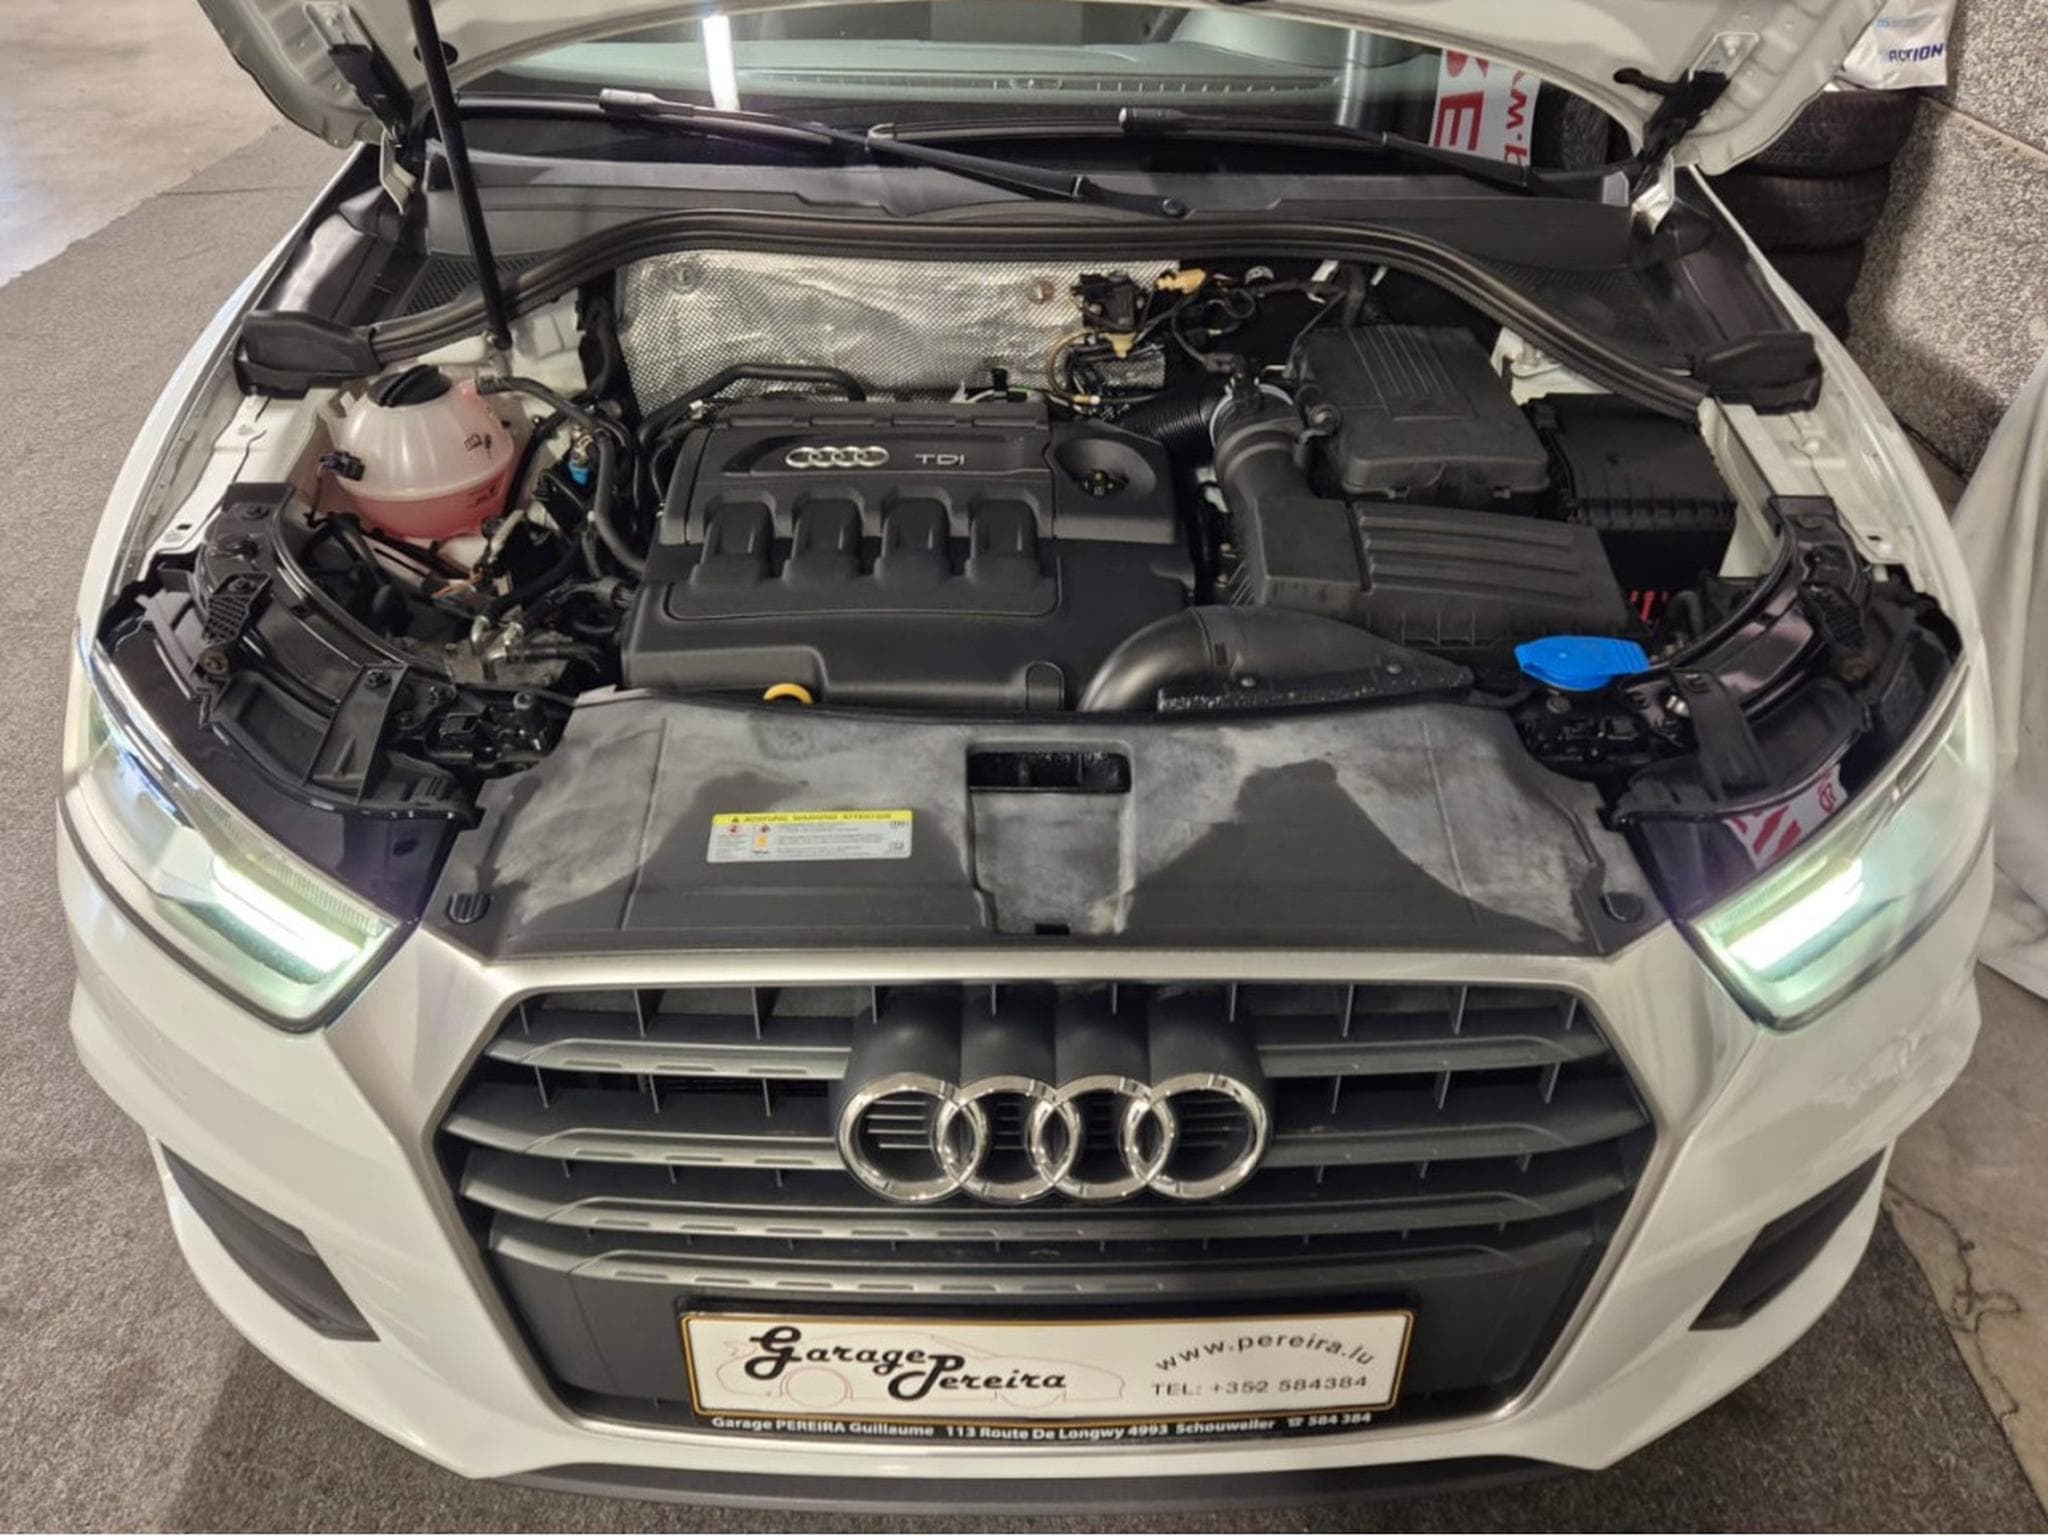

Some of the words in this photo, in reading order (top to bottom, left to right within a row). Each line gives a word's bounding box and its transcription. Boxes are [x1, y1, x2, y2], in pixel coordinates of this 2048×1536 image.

[1888, 43, 1944, 63] ACTION
[914, 452, 966, 466] TDI
[744, 1326, 927, 1381] Garage
[1155, 1332, 1375, 1372] www.pereira.lu
[887, 1354, 1068, 1401] Pereira
[1152, 1382, 1201, 1397] TEL:
[1213, 1380, 1269, 1395] +352
[1278, 1375, 1368, 1393] 584384
[711, 1416, 773, 1432] Garage
[776, 1418, 846, 1433] PEREIRA
[850, 1421, 934, 1437] Guillaume
[946, 1426, 976, 1438] 113
[979, 1427, 1029, 1440] Route
[1032, 1428, 1055, 1440] De
[1059, 1427, 1125, 1441] Longwy
[1176, 1418, 1276, 1435] Schouweiler
[1308, 1413, 1338, 1427] 584
[1341, 1412, 1372, 1424] 384
